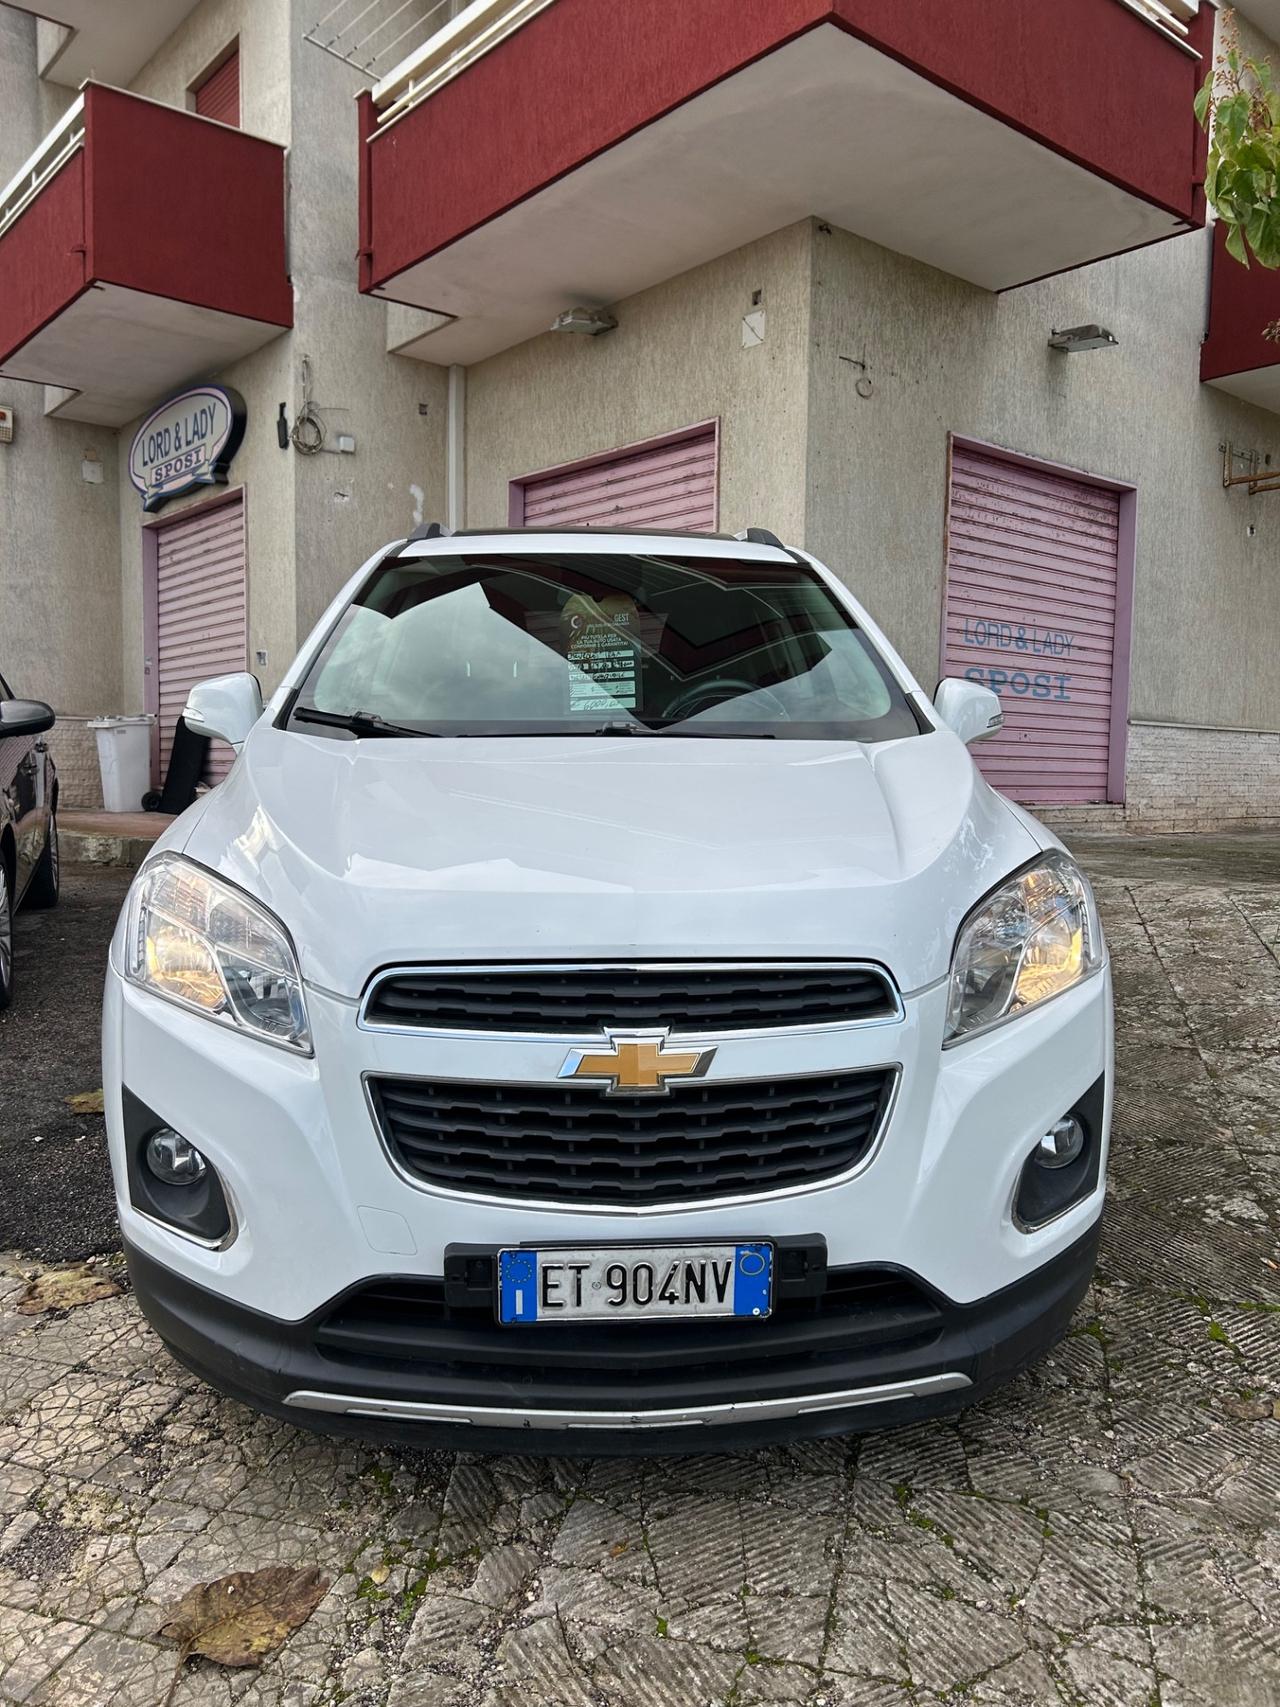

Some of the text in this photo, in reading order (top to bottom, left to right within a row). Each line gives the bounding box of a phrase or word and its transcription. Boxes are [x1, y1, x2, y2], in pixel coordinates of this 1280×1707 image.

[142, 403, 216, 467] LORD & LADY
[155, 449, 203, 481] SPOSI
[964, 618, 1074, 656] LORD & LADY
[964, 666, 1072, 700] SPOSI
[541, 1262, 590, 1308] ET
[606, 1259, 732, 1306] 904NV
